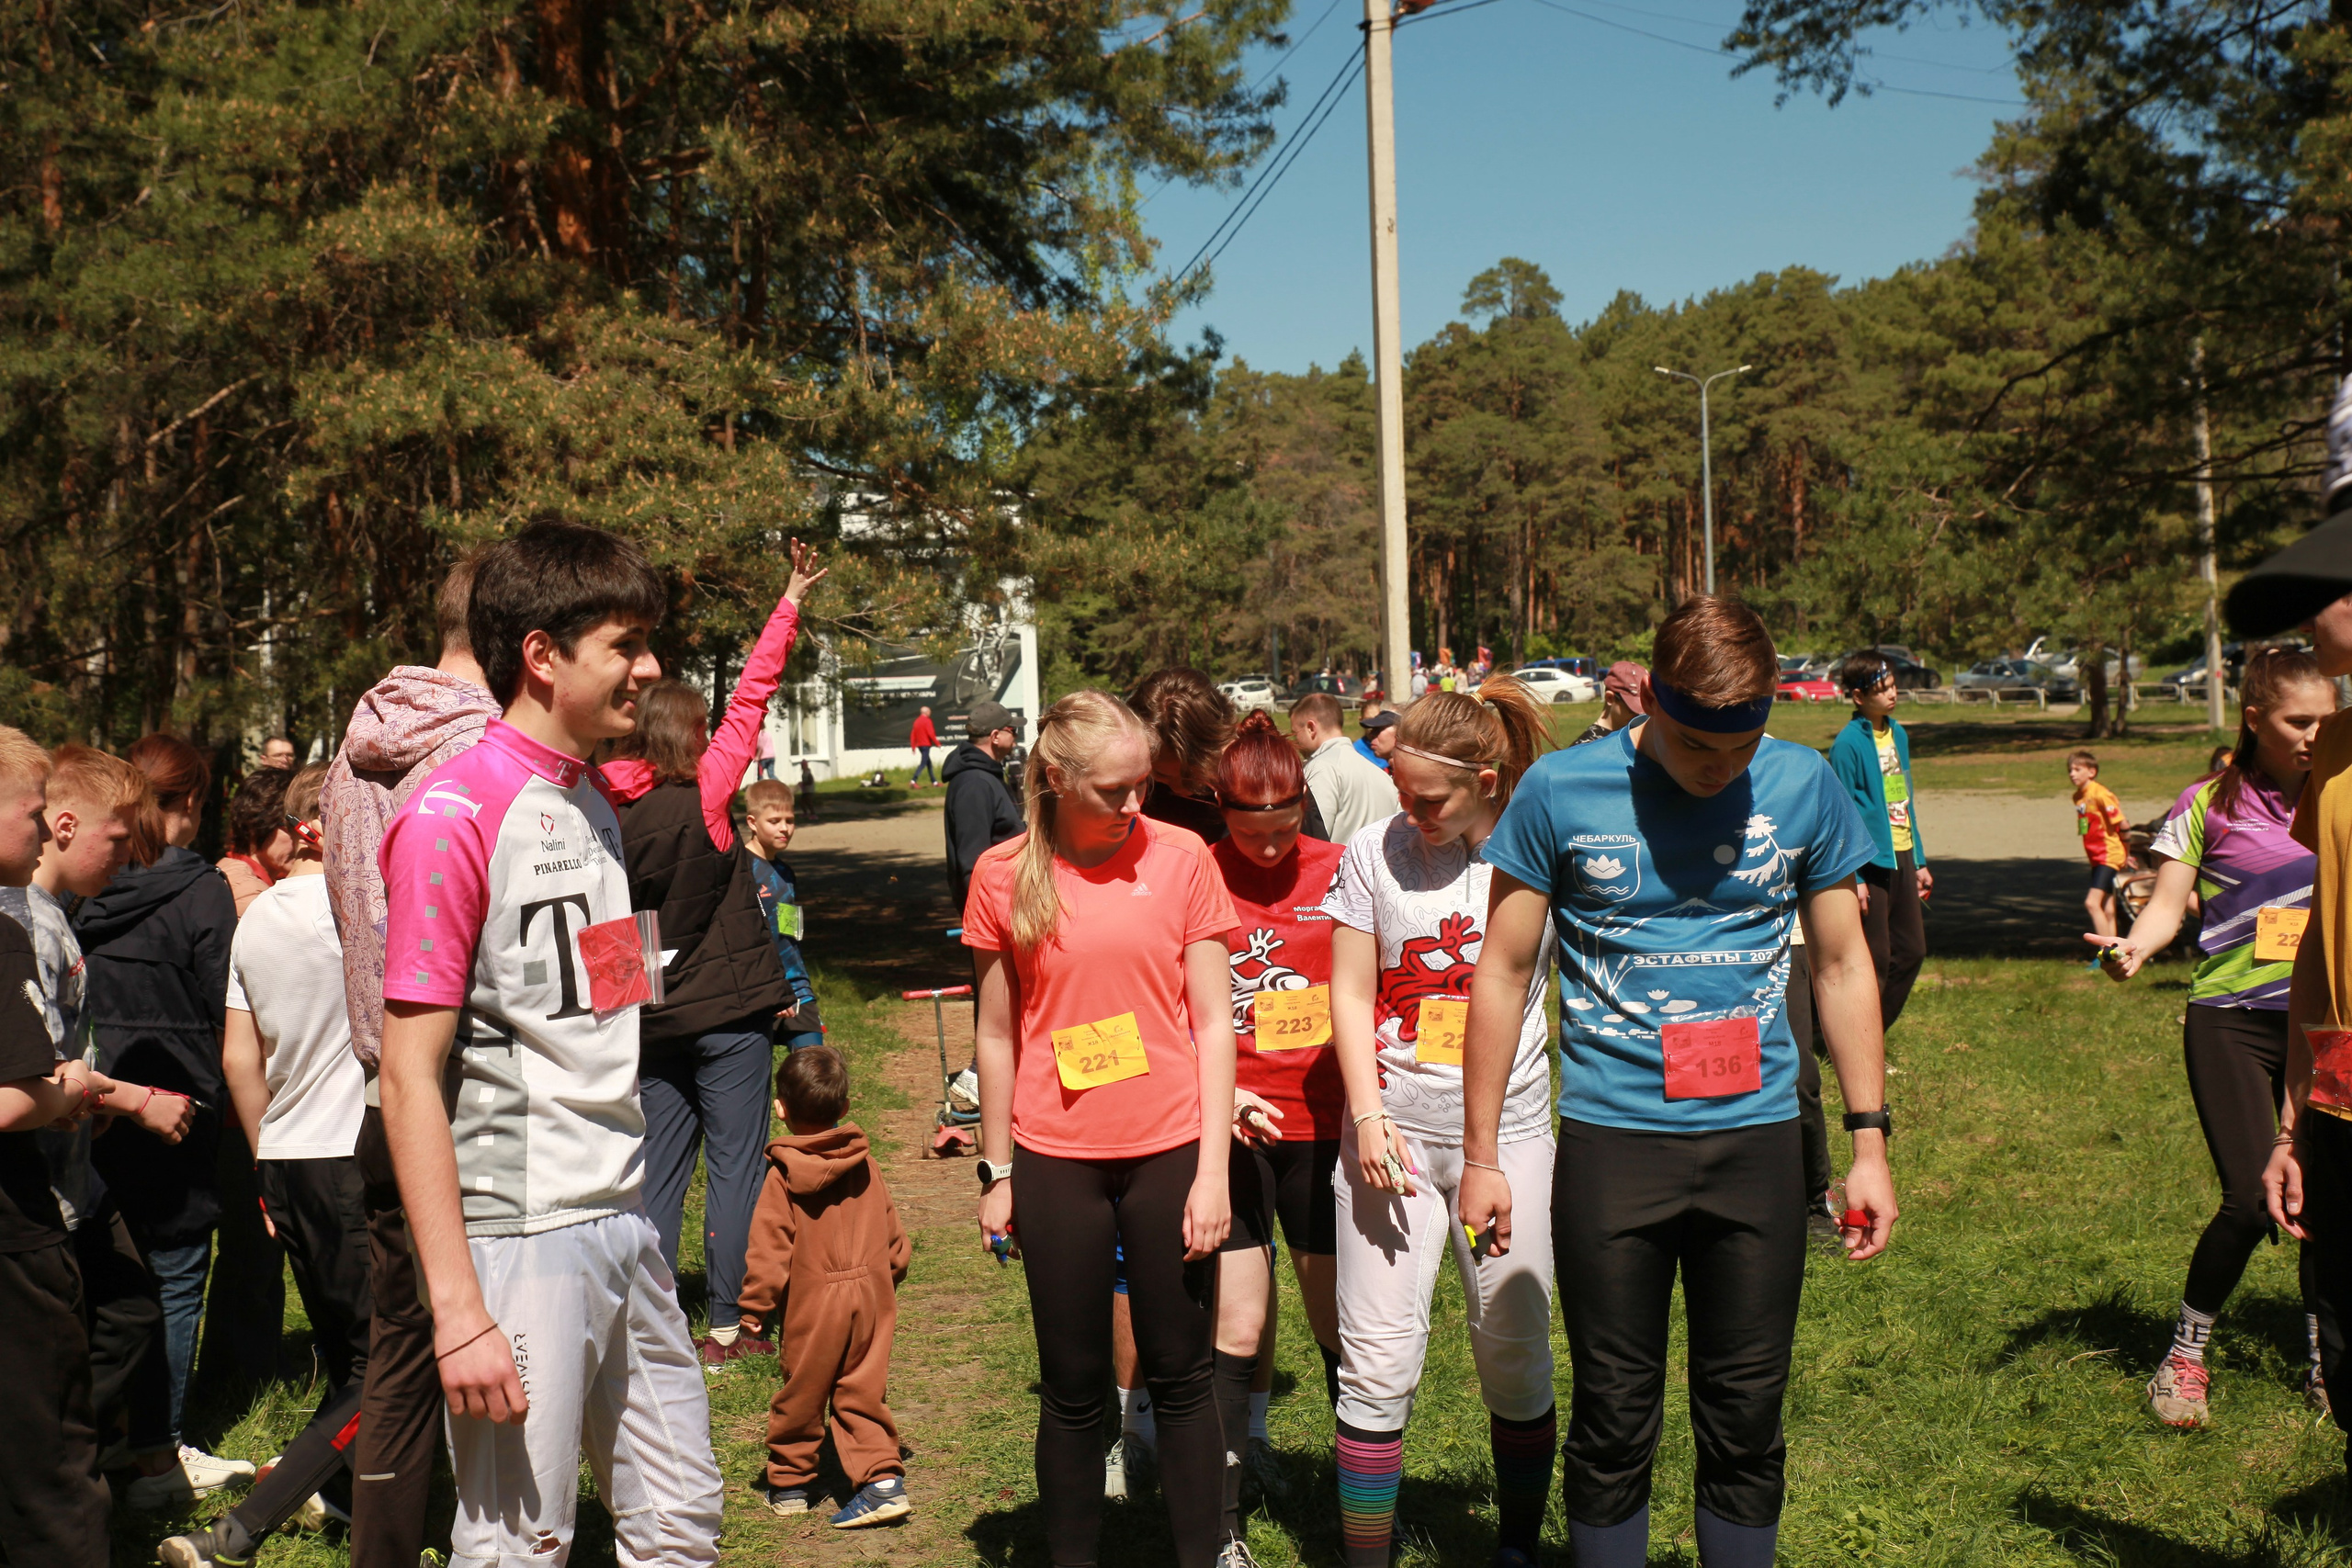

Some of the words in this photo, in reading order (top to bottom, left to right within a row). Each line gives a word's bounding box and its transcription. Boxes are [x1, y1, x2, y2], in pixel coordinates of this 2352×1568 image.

[540, 837, 567, 852] Nalini
[1572, 834, 1636, 843] ЧЕБАРКУЛЬ
[534, 858, 582, 875] PINARELLO
[520, 892, 593, 1021] T
[1633, 953, 1740, 965] ЭСТАФЕТЫ
[1275, 1016, 1313, 1035] 223
[1079, 1049, 1120, 1075] 221
[1695, 1055, 1742, 1078] 136
